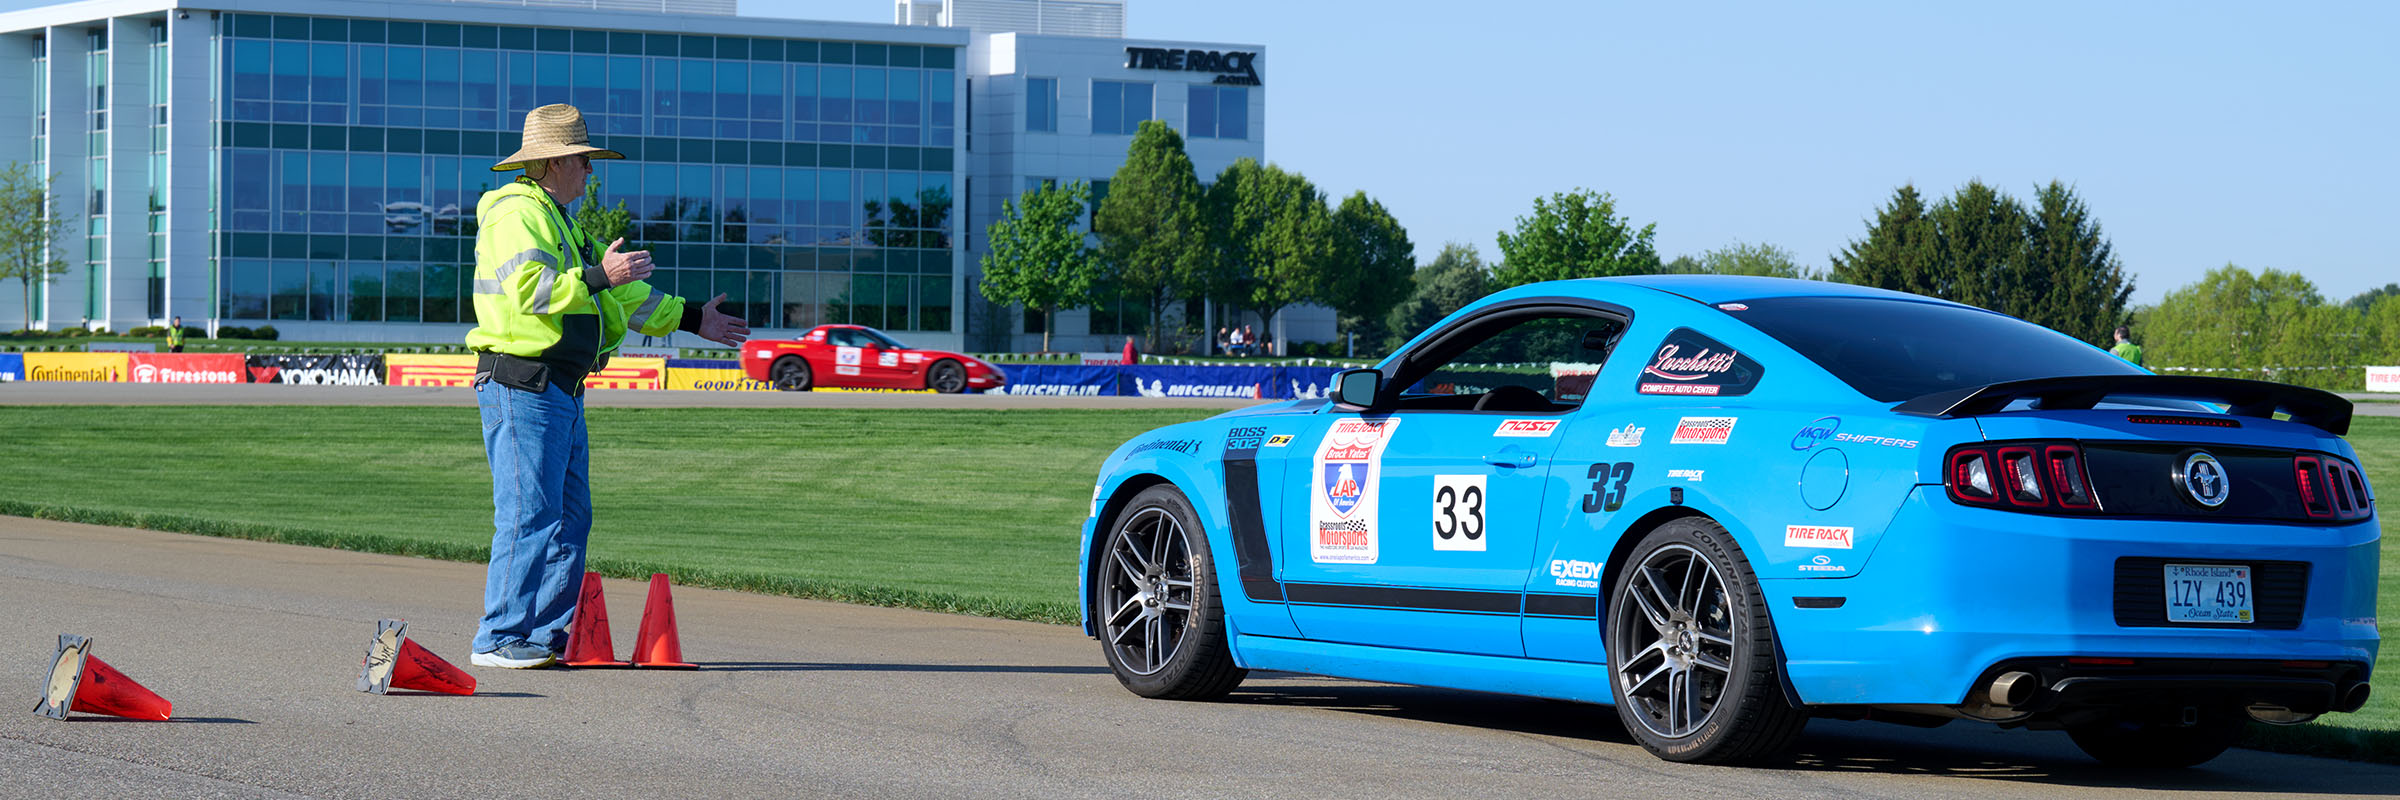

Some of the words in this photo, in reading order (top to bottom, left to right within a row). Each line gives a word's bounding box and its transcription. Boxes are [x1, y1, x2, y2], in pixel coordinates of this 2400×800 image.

[1126, 47, 1185, 71] TIRE
[1185, 50, 1261, 86] RACK
[1645, 344, 1737, 380] Lucchetti's
[31, 365, 108, 382] Continental
[160, 367, 238, 383] Firestone
[279, 368, 379, 386] YOKOHAMA
[1010, 384, 1101, 396] MICHELIN
[1168, 384, 1256, 398] MICHELIN
[1641, 384, 1675, 393] COMPLETE
[1675, 385, 1692, 393] AUTO
[1692, 386, 1719, 394] CENTER
[1228, 426, 1267, 438] BOSS
[1335, 422, 1362, 433] TIRE
[1358, 422, 1389, 438] RACK
[1674, 425, 1730, 442] Motorsports
[1228, 438, 1259, 450] 302
[1834, 433, 1920, 449] SHIFTERS
[1327, 448, 1347, 459] Brock
[1333, 479, 1357, 497] LAP
[1582, 462, 1634, 514] 33
[1435, 485, 1484, 540] 33
[1319, 527, 1368, 550] Motorsports
[1789, 527, 1816, 539] TIRE
[1815, 528, 1850, 547] RACK
[1551, 559, 1604, 579] EXEDY
[2185, 567, 2209, 577] Rhode
[2210, 567, 2231, 577] Island
[1555, 578, 1576, 587] RACING
[1576, 580, 1598, 588] CLUTCH
[1691, 529, 1750, 648] CONTINENTAL
[2173, 580, 2202, 607] 1ZY
[2216, 581, 2246, 607] 439
[2188, 607, 2212, 618] Ocean
[2213, 608, 2234, 619] State
